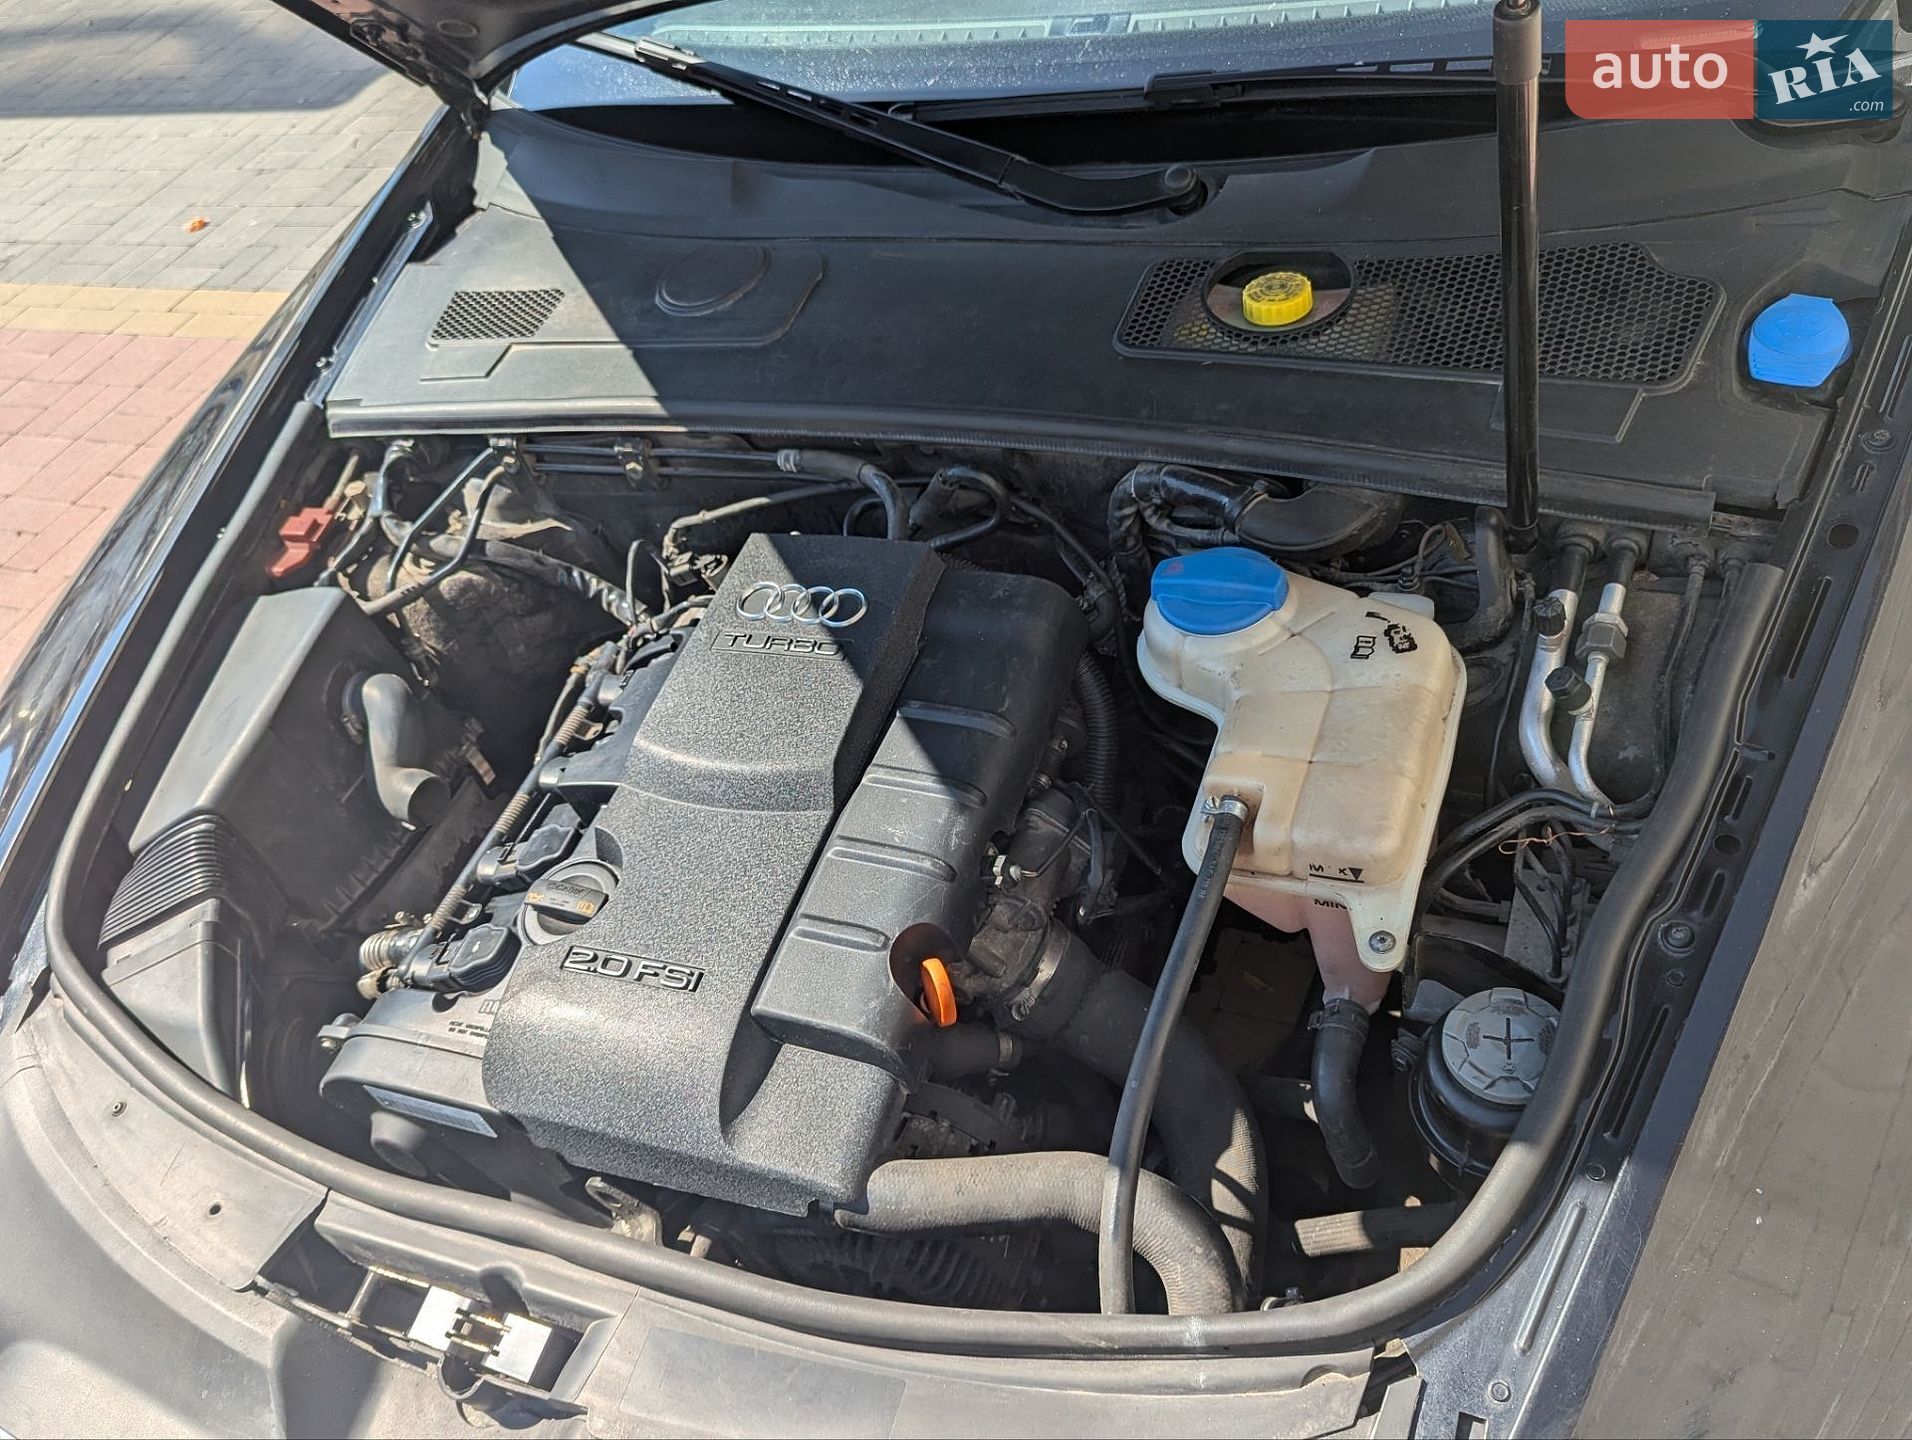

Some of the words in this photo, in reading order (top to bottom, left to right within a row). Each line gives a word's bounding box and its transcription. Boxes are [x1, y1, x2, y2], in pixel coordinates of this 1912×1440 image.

[724, 633, 844, 656] TURBO
[1309, 863, 1348, 876] MX
[1314, 898, 1348, 910] MIN
[564, 950, 632, 978] 2.0
[634, 961, 704, 992] FSI
